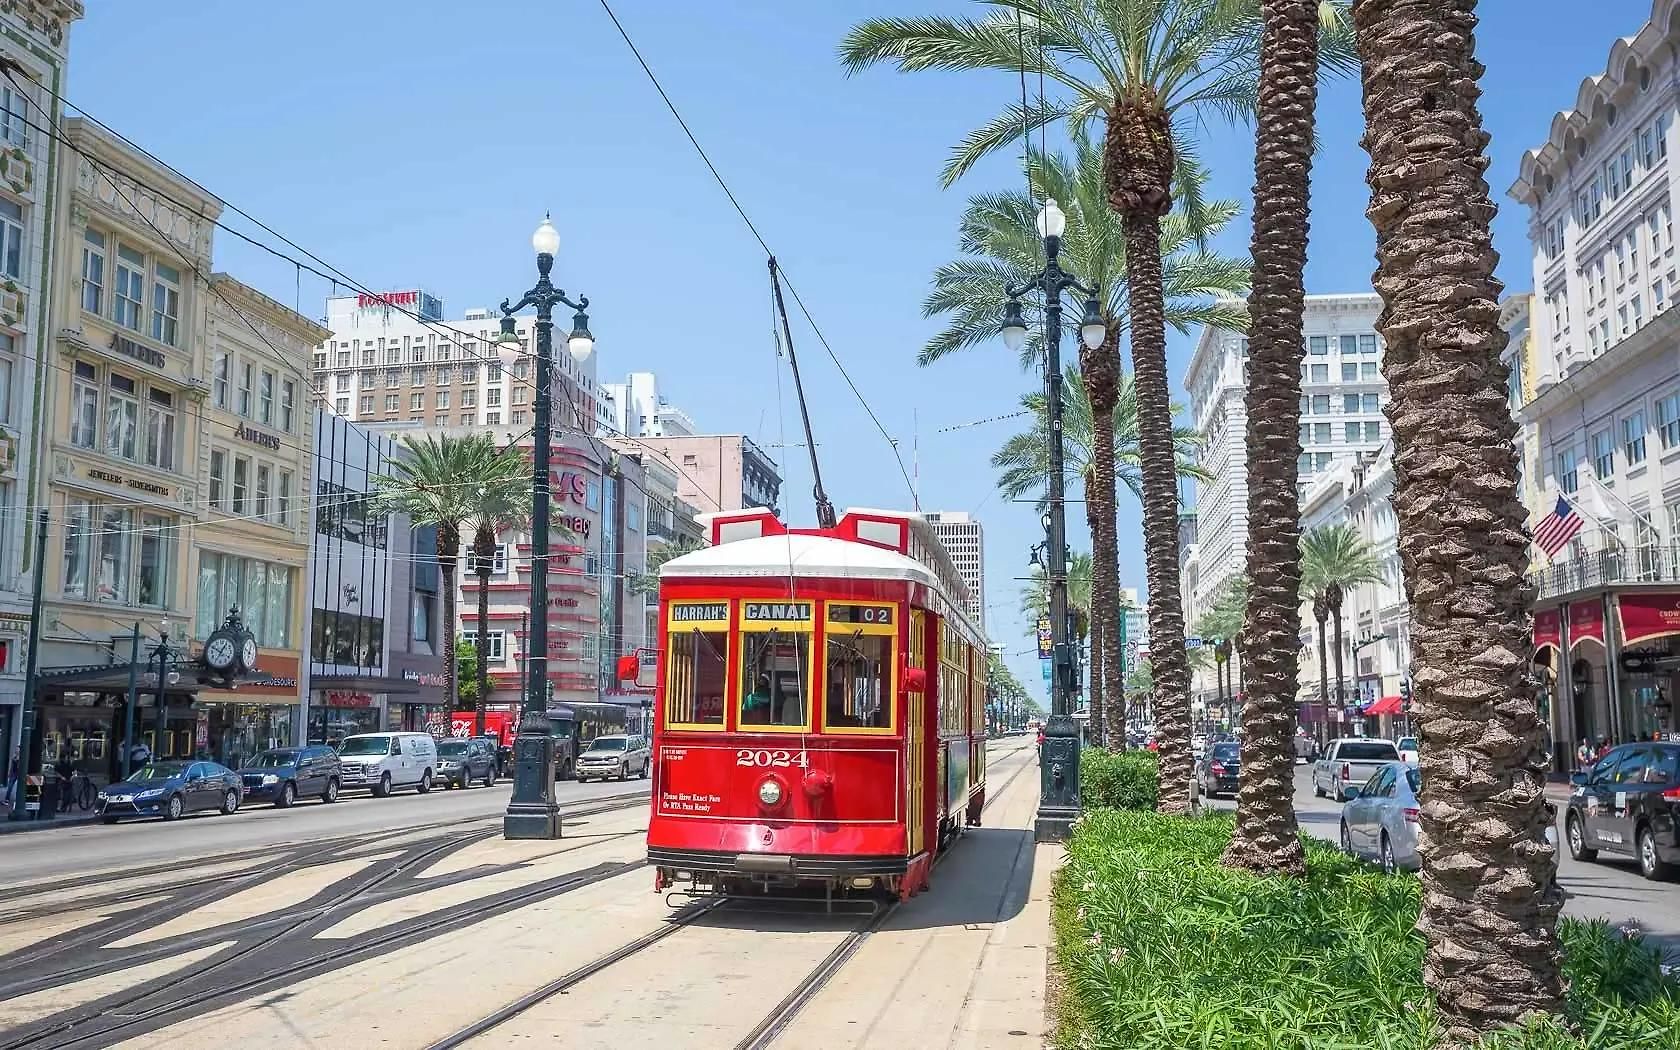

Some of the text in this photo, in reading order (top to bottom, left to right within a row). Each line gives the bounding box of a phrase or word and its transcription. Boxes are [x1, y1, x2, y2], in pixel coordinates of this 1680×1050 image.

[673, 605, 728, 621] HARRAH'S
[745, 602, 810, 621] CANAL
[736, 749, 809, 768] 2024
